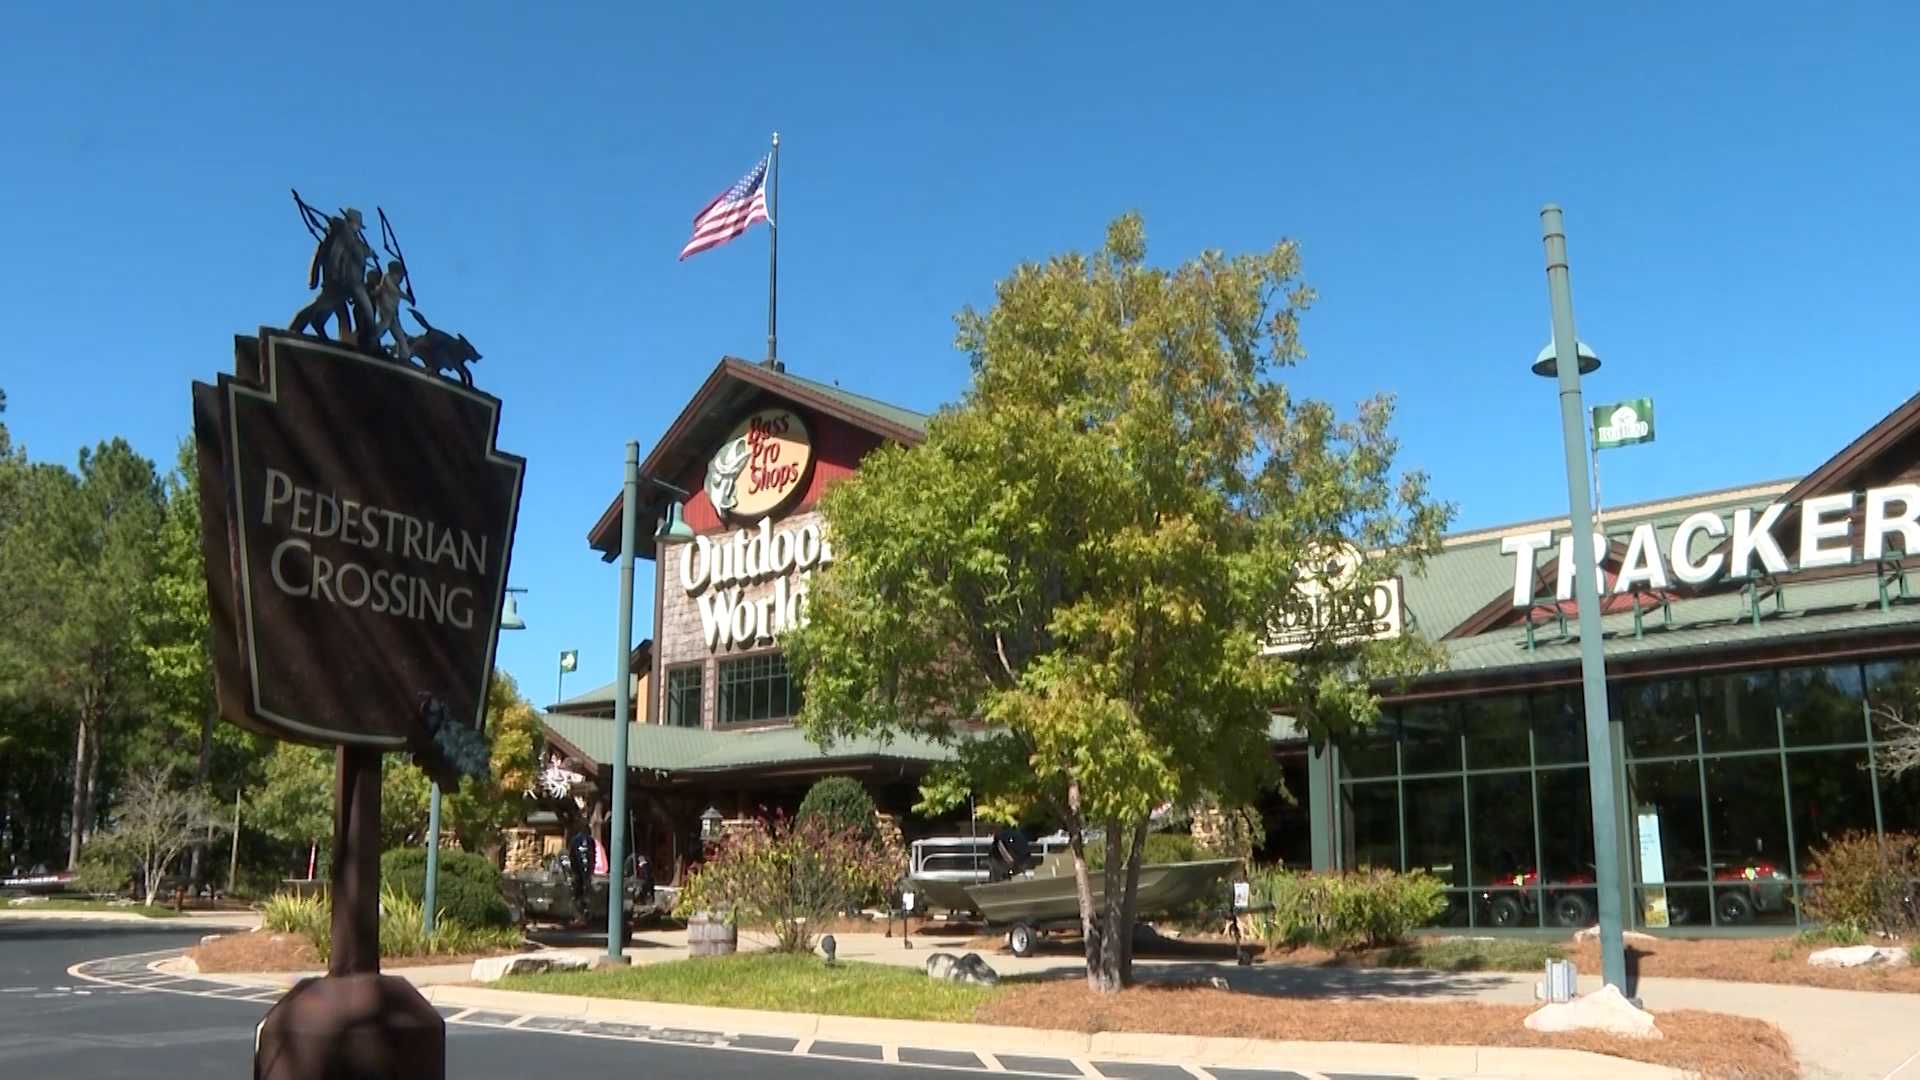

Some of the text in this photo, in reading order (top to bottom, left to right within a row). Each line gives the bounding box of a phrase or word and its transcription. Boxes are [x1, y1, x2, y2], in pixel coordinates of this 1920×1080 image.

[748, 416, 790, 445] Bass
[751, 441, 780, 470] Pro
[748, 462, 799, 494] Shops
[262, 467, 487, 575] PEDESTRIAN
[1501, 483, 1920, 607] TRACKER
[271, 538, 474, 629] CROSSING
